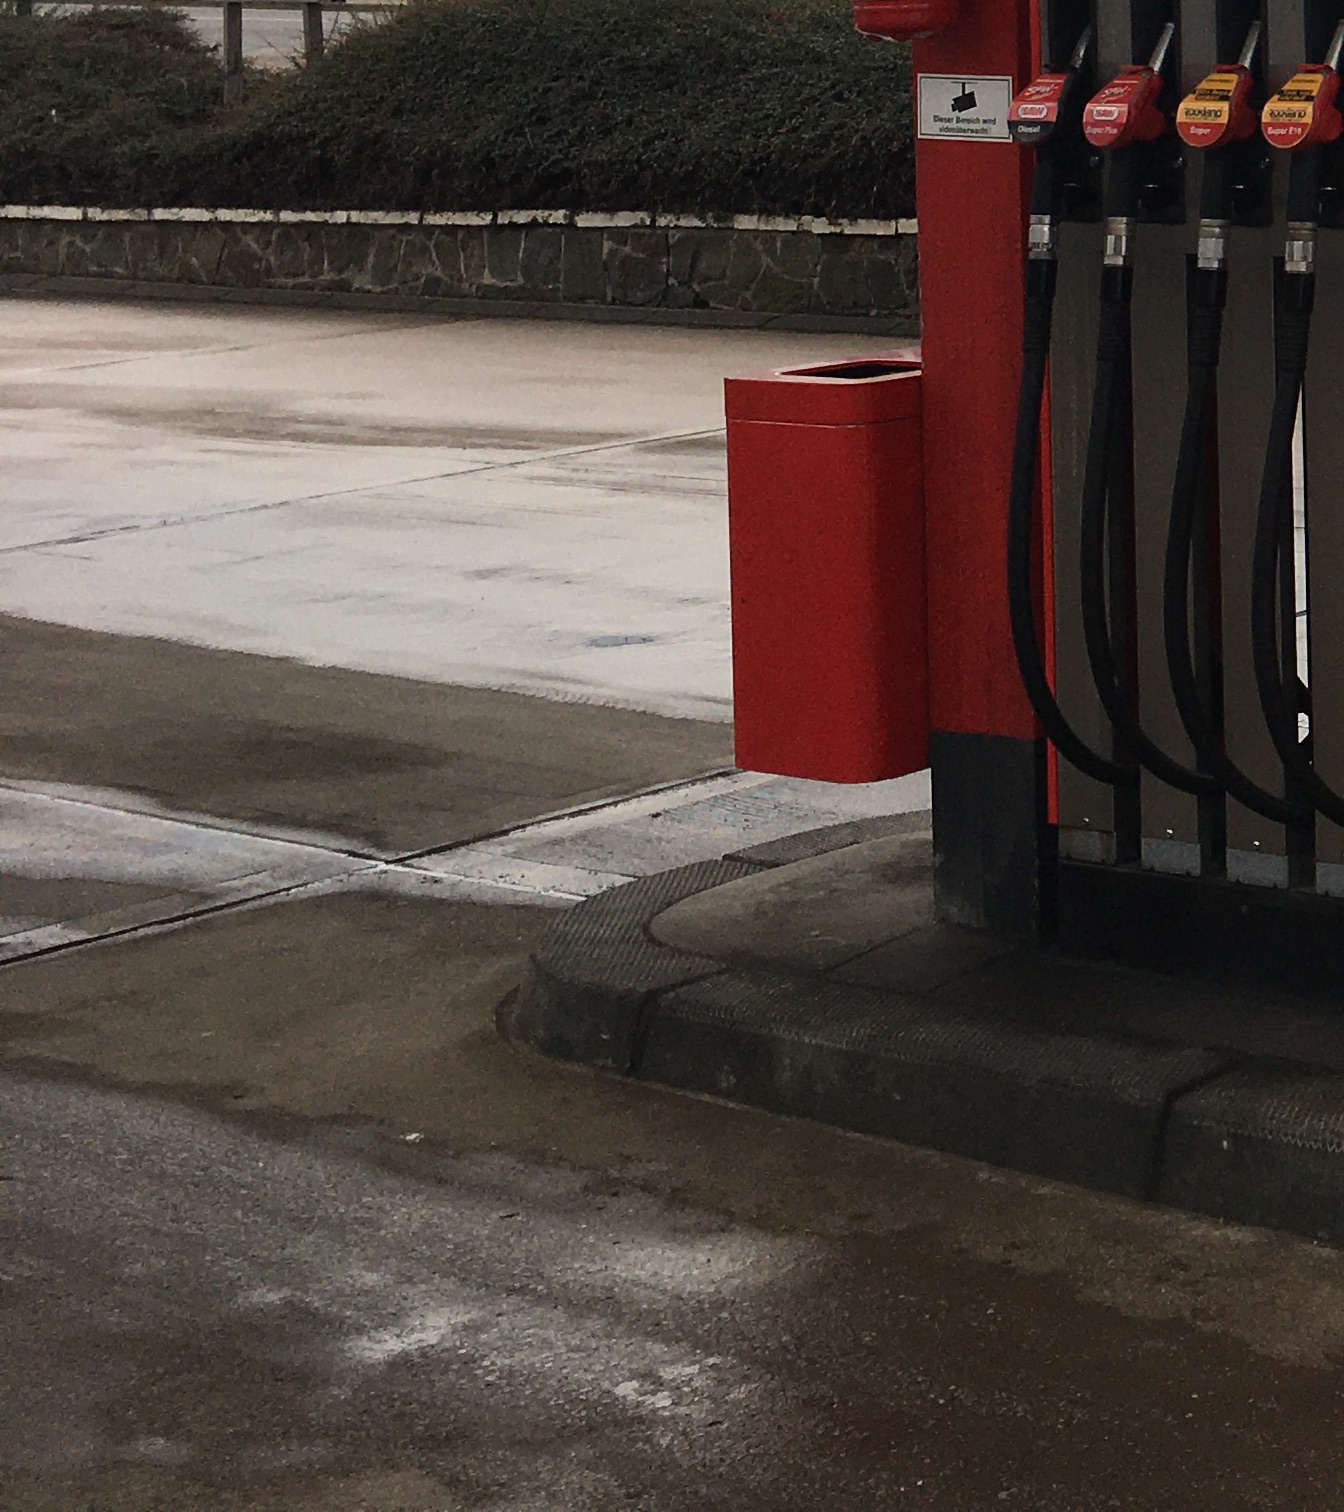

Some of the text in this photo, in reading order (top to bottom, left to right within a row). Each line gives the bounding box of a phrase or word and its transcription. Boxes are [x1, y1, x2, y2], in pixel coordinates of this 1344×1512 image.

[1017, 125, 1041, 134] Diesel
[1086, 126, 1104, 135] Super
[1189, 126, 1211, 135] Super
[1267, 126, 1288, 136] Super
